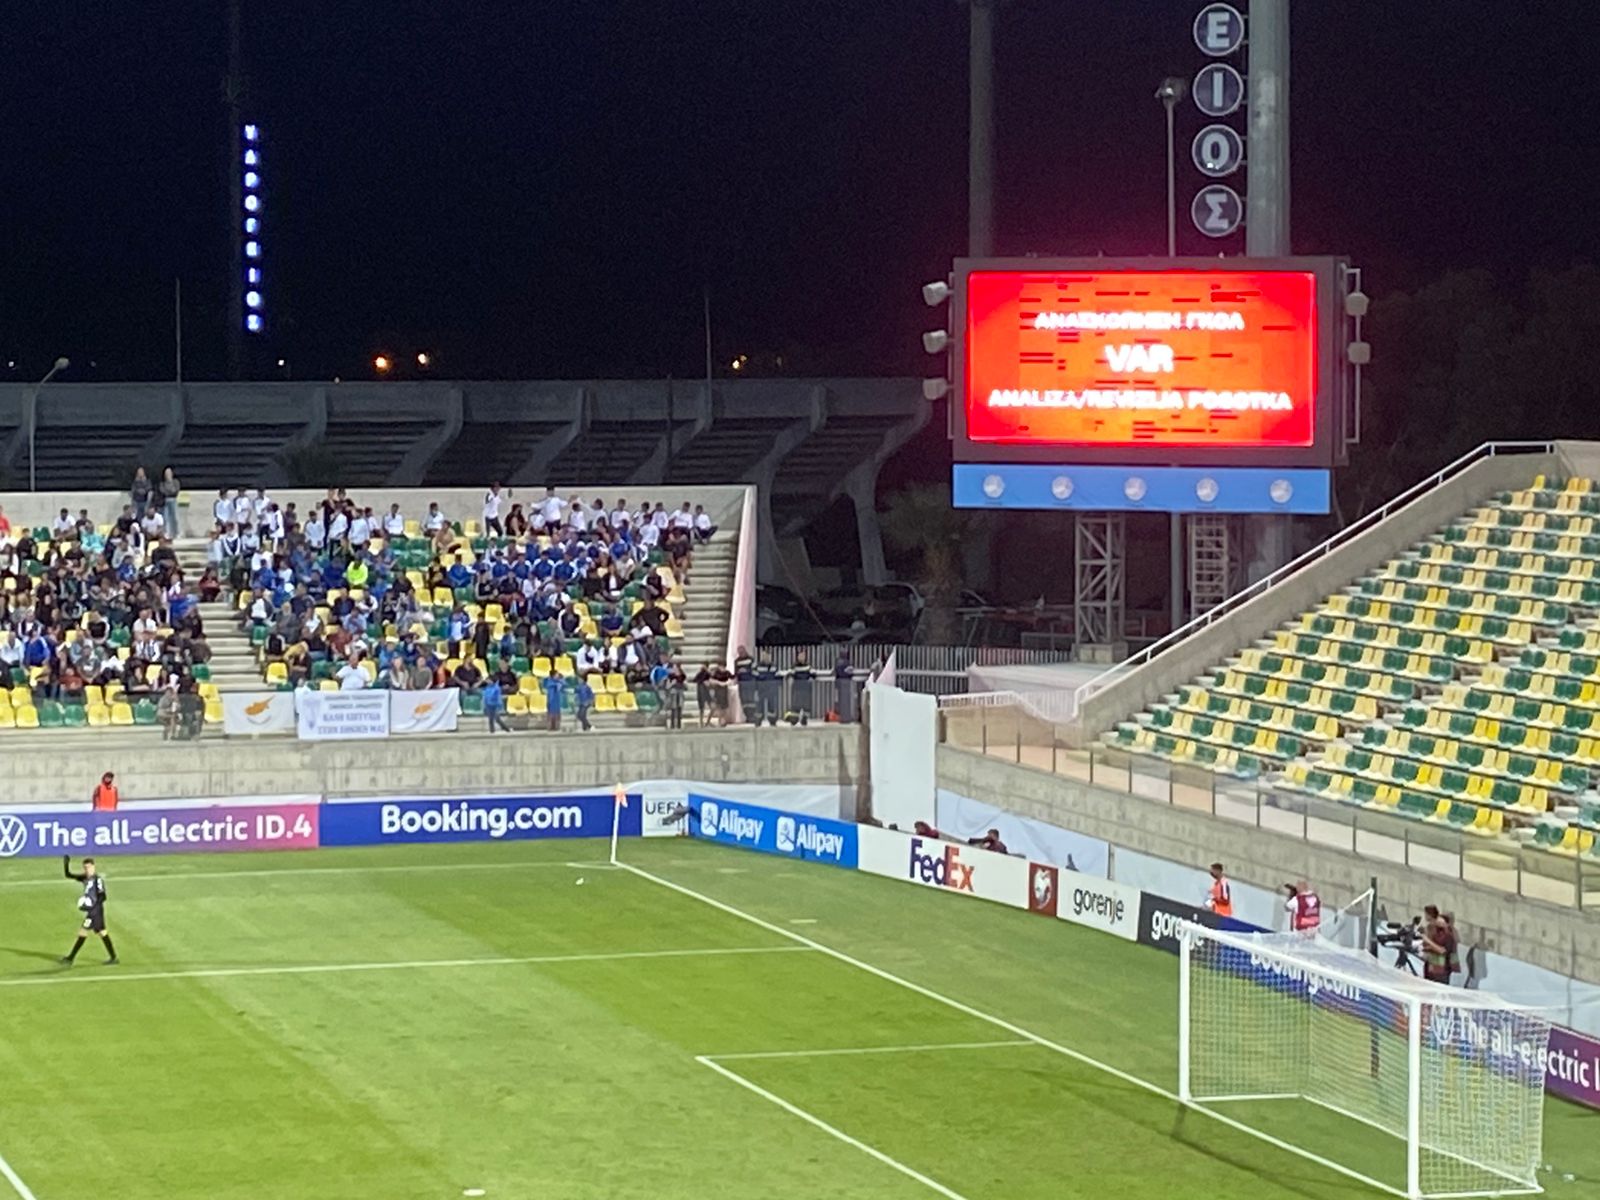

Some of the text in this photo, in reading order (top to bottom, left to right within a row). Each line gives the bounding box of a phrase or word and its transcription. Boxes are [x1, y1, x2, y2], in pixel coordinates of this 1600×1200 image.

[1104, 344, 1175, 373] VAR
[33, 812, 312, 847] The all-electric ID.4
[381, 801, 582, 837] Booking.com
[719, 809, 763, 843] Alipay
[797, 822, 843, 860] Alipay
[909, 837, 974, 892] FedEx
[1073, 887, 1124, 924] gorenje
